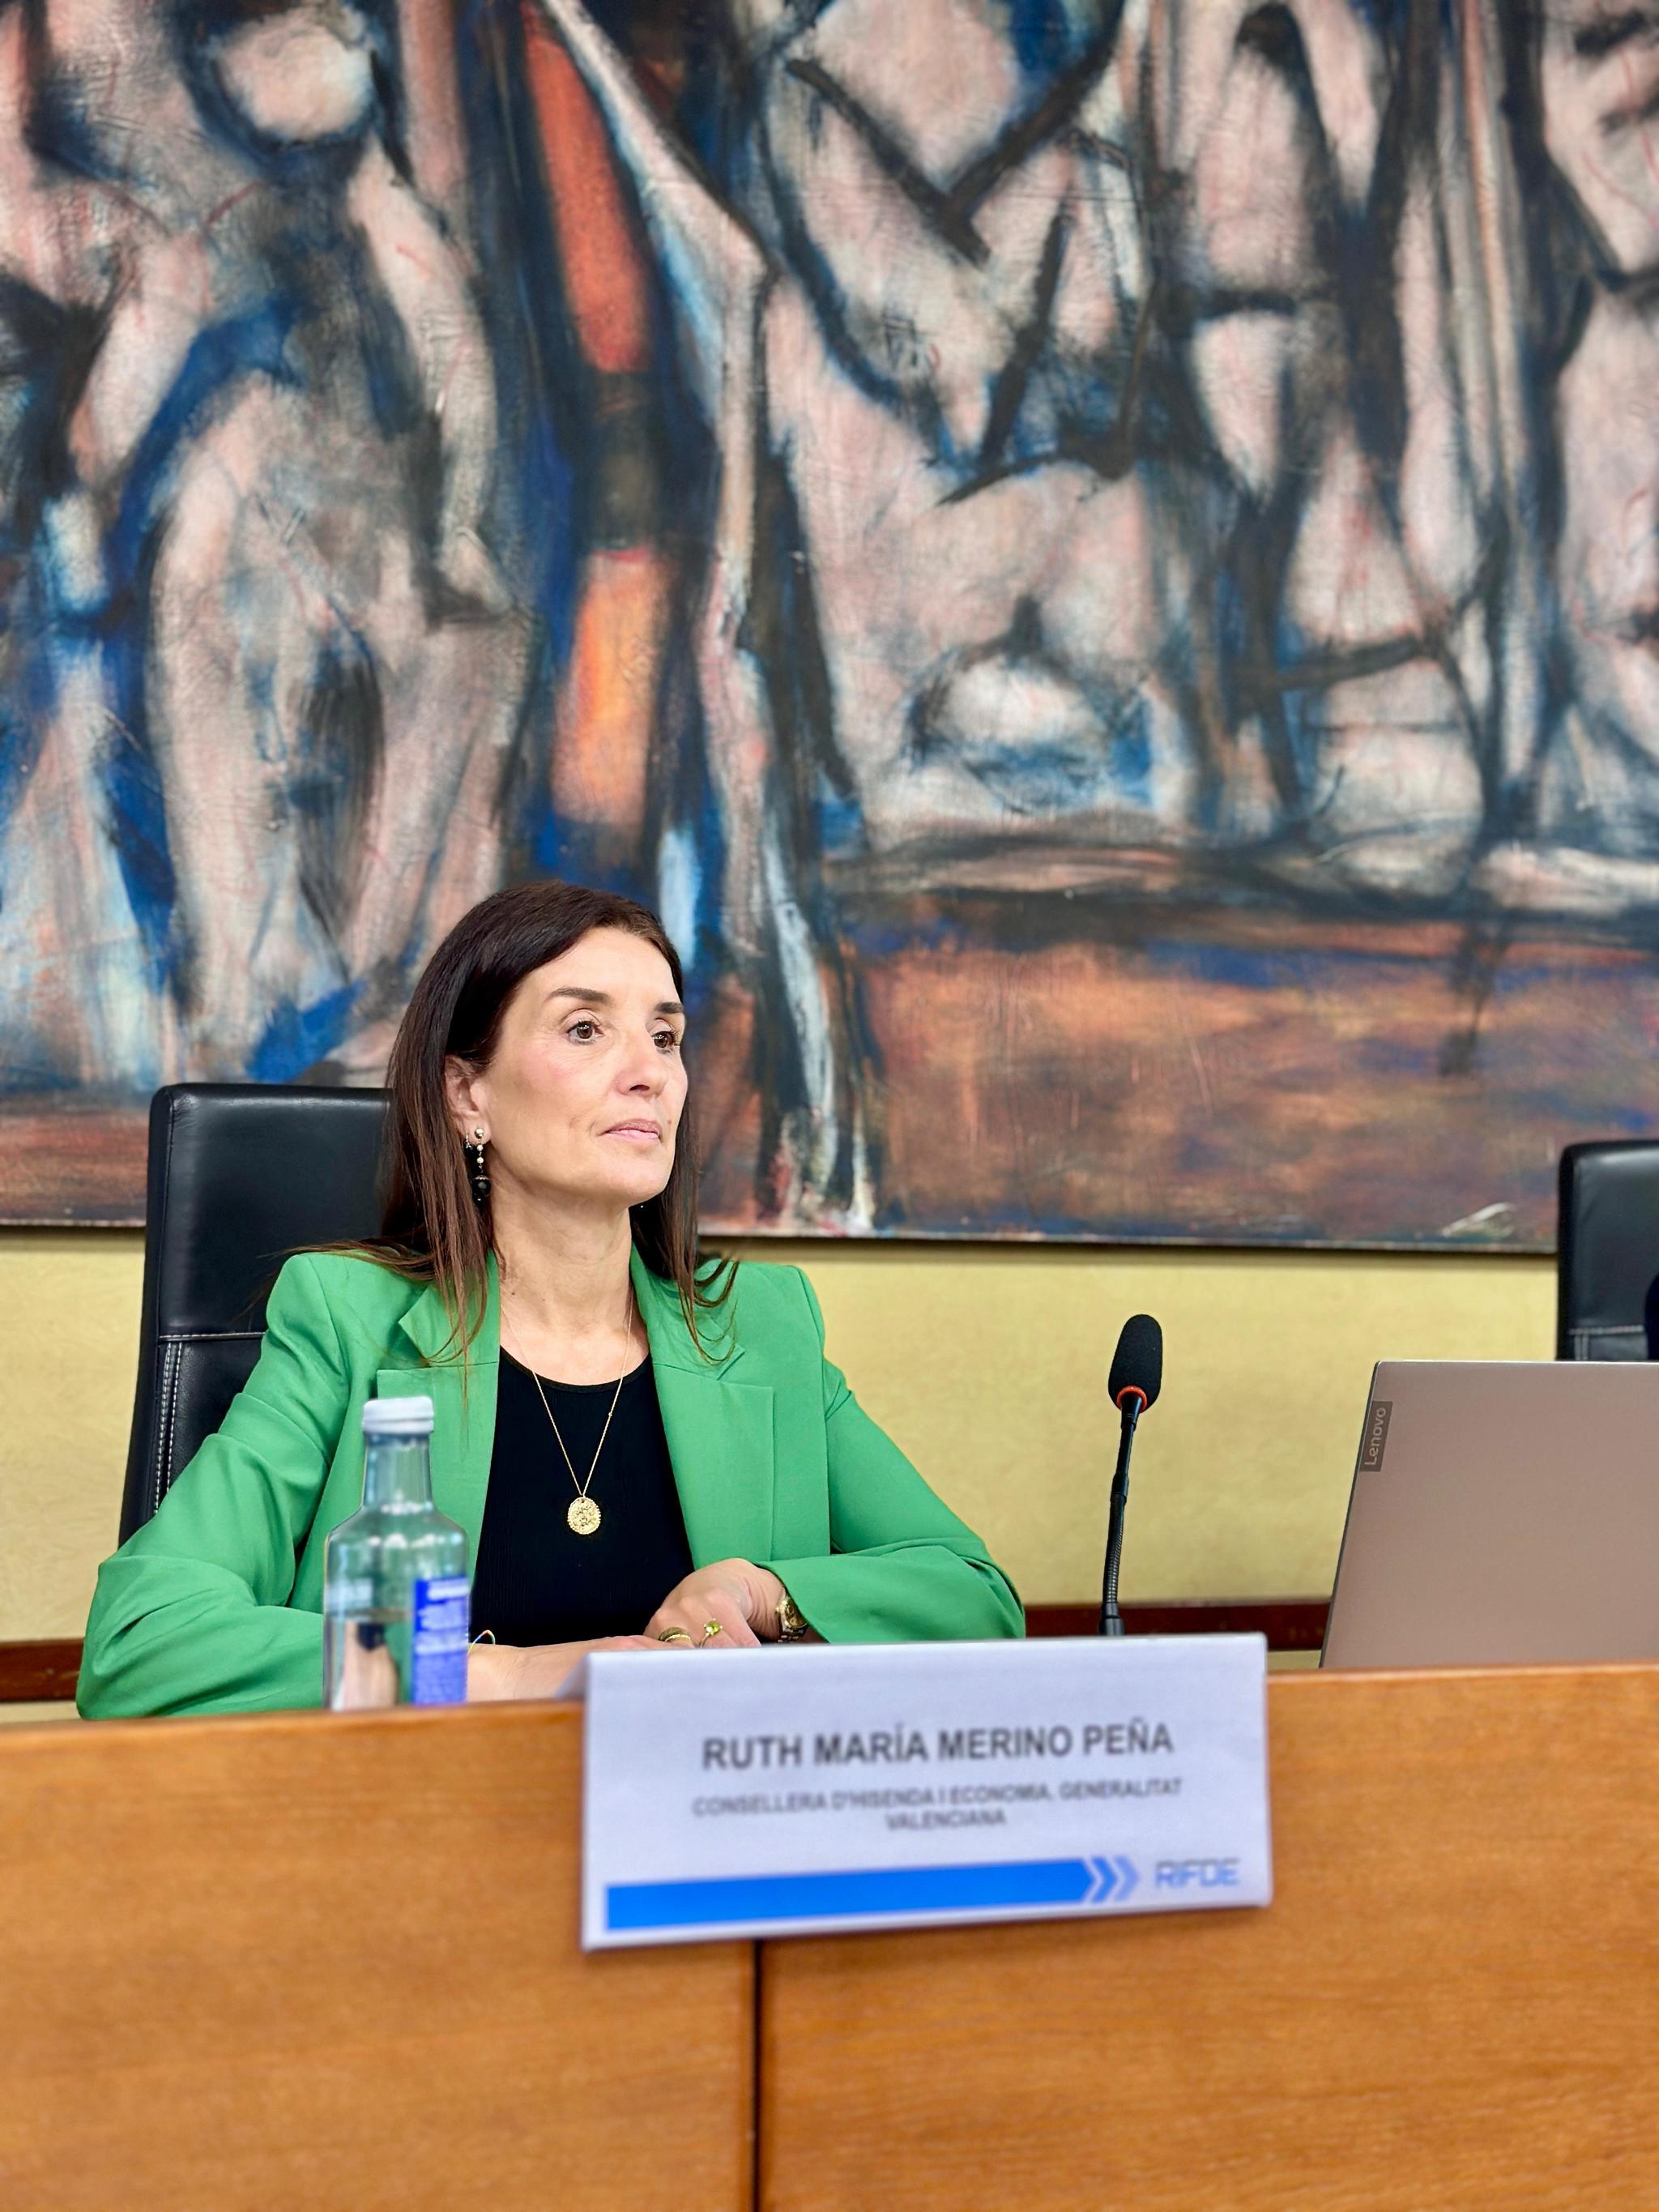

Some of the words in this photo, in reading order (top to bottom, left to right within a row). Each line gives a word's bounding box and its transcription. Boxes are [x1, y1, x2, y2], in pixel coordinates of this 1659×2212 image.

[1364, 1407, 1387, 1466] Lenovo
[702, 1734, 803, 1771] RUTH
[813, 1721, 929, 1766] MARÍA
[937, 1724, 1073, 1761] MERINO
[1082, 1717, 1174, 1757] PEÑA
